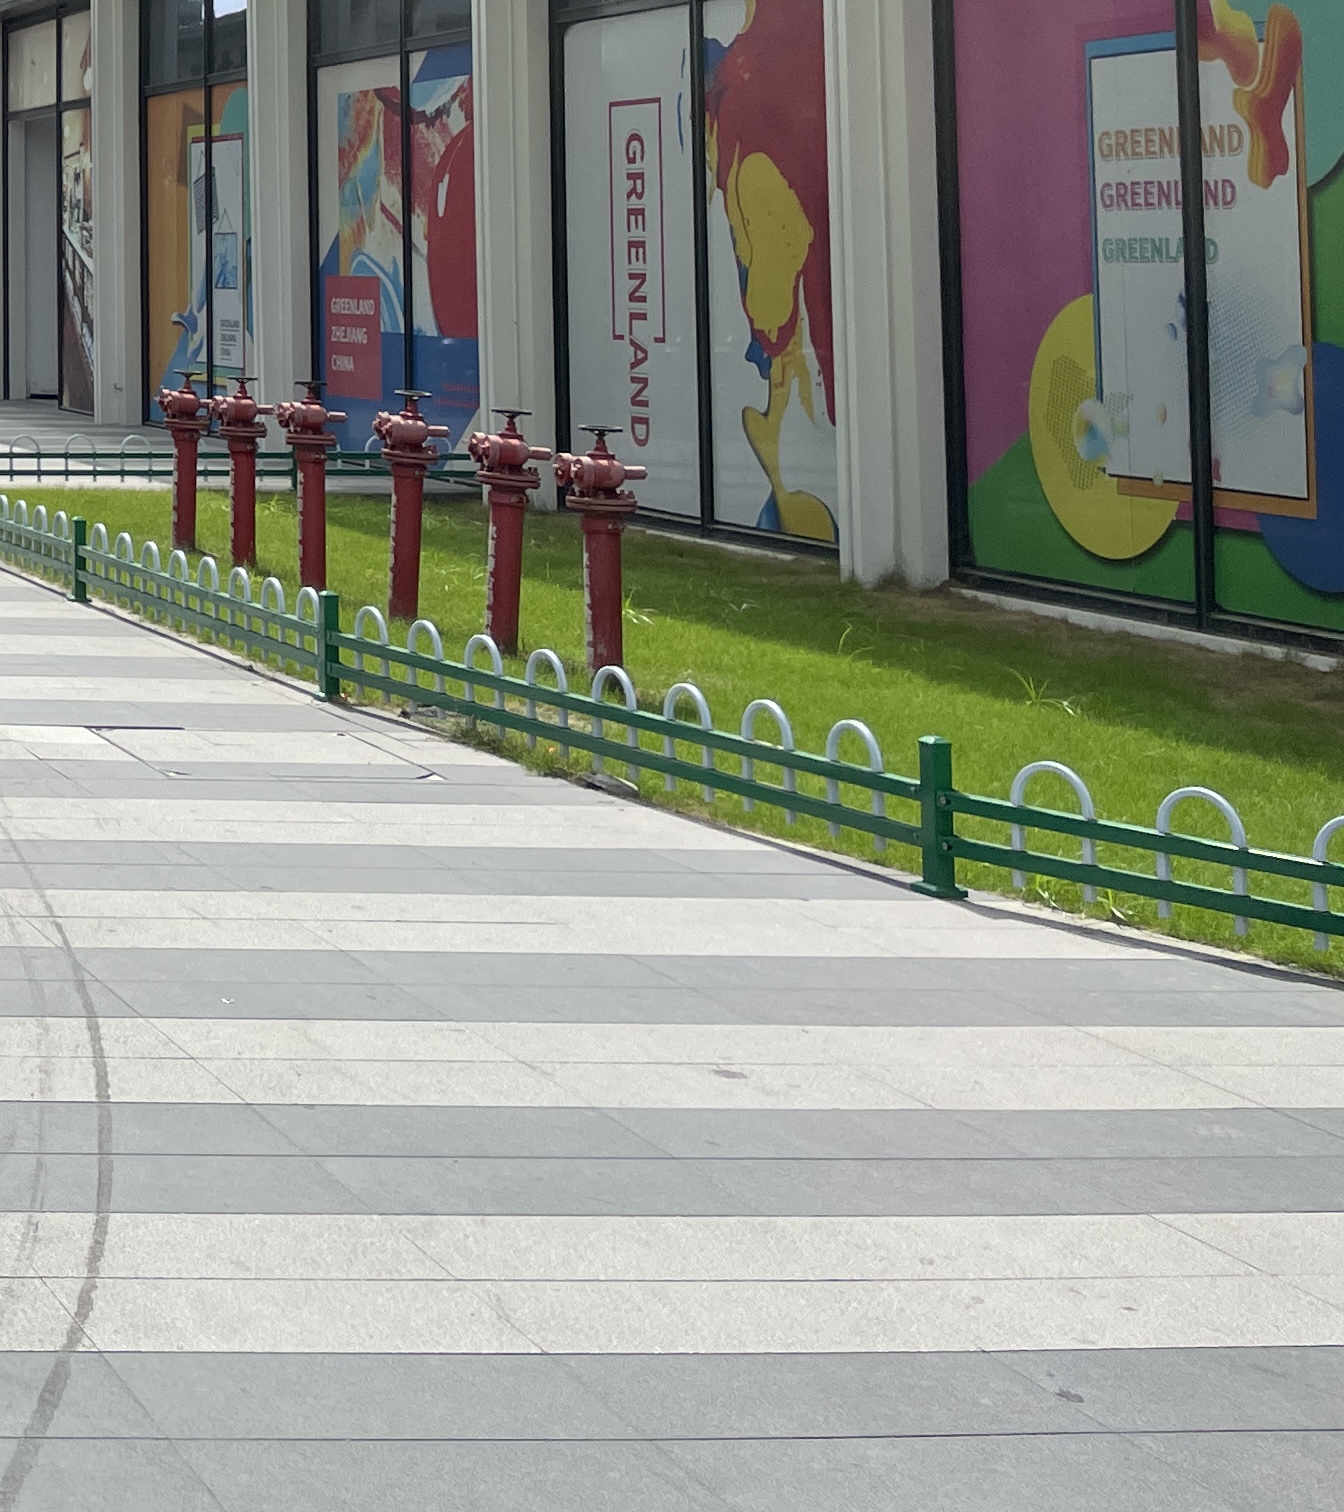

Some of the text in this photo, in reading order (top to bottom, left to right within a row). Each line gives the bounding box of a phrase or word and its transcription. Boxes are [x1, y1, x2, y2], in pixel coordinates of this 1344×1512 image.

[1098, 124, 1244, 161] GREENAND
[1100, 179, 1236, 210] GREENLND
[1102, 237, 1219, 265] GREENLAD
[625, 129, 650, 448] GREENLAND
[330, 297, 375, 316] GREENLAND
[331, 326, 368, 345] ZHEJIANG
[331, 354, 355, 372] CHINA
